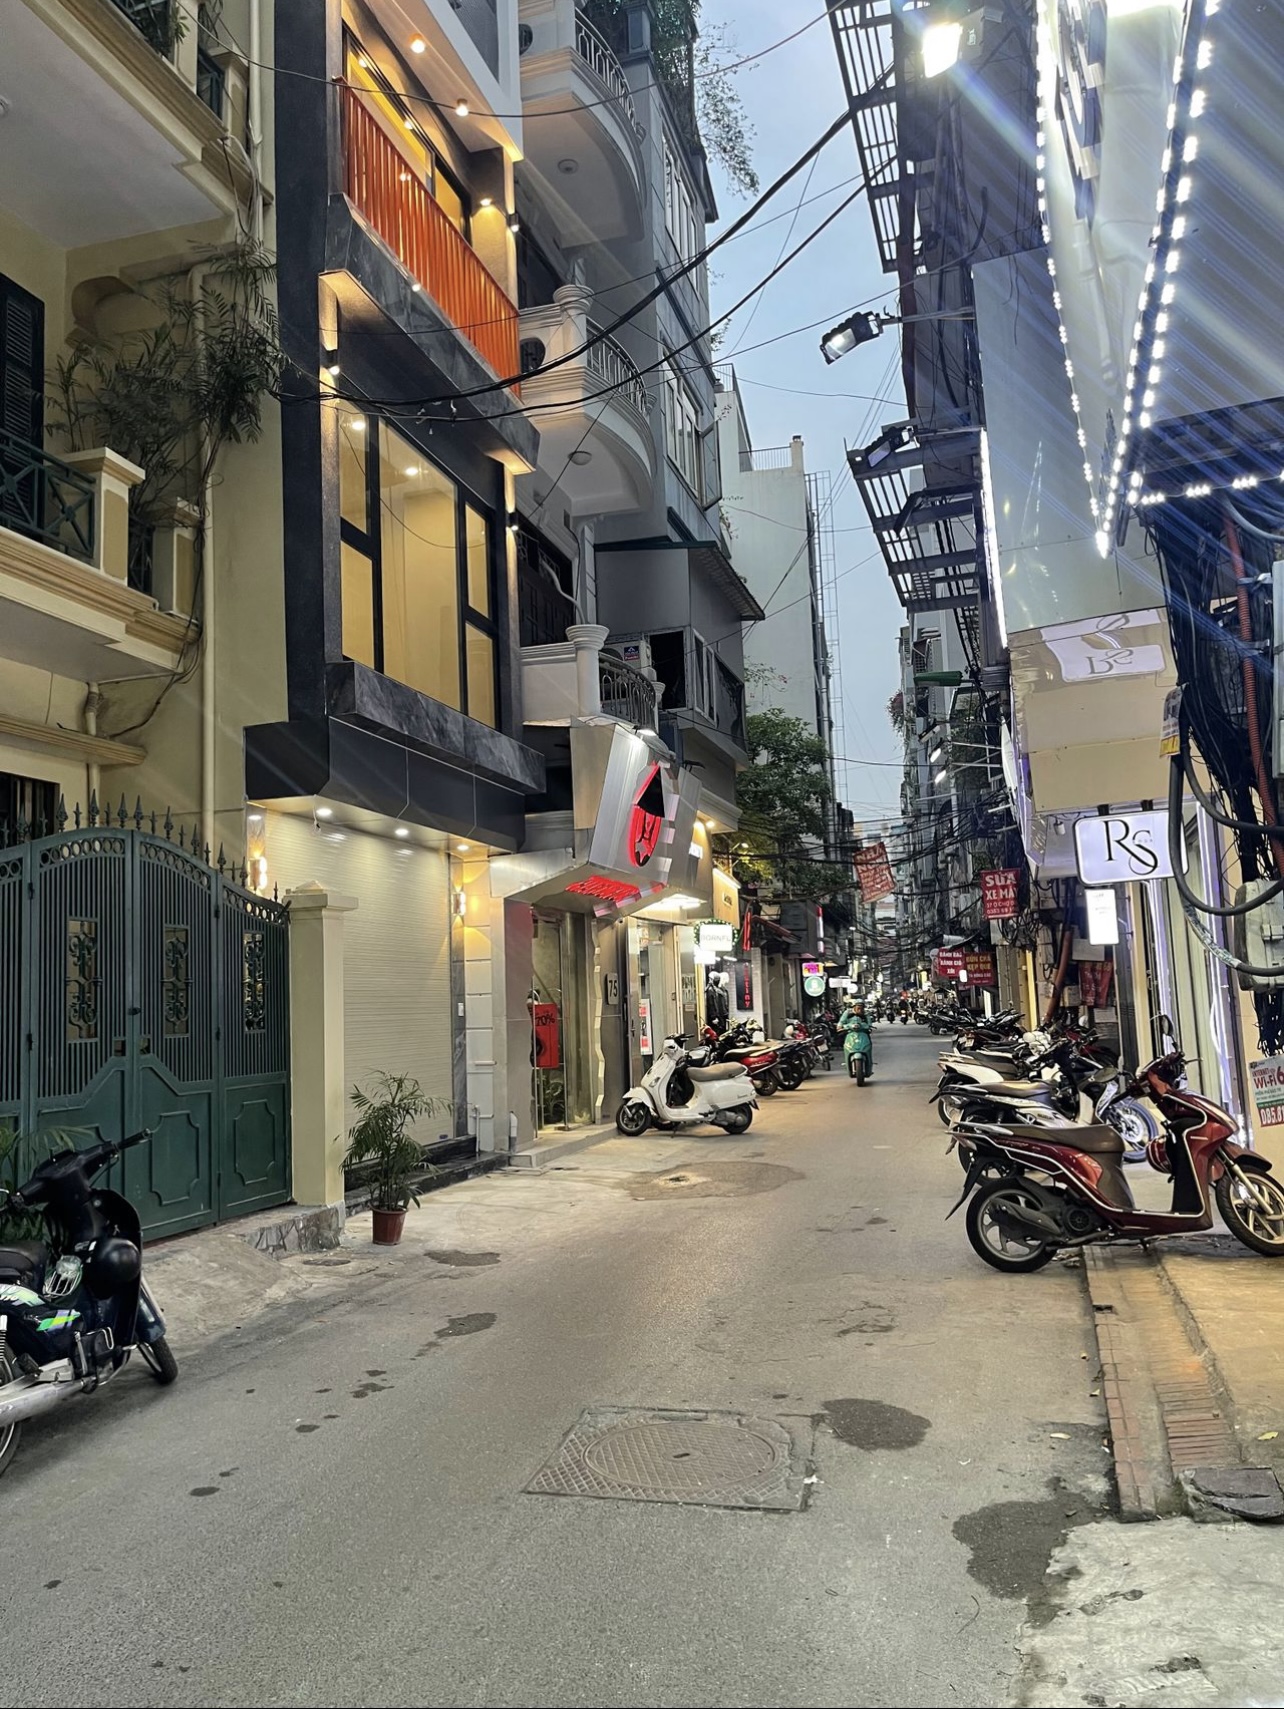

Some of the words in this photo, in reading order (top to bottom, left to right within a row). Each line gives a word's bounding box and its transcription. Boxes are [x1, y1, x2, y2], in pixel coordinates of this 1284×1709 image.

[985, 890, 998, 900] XE
[608, 979, 618, 998] 75
[1277, 1066, 1284, 1085] 6
